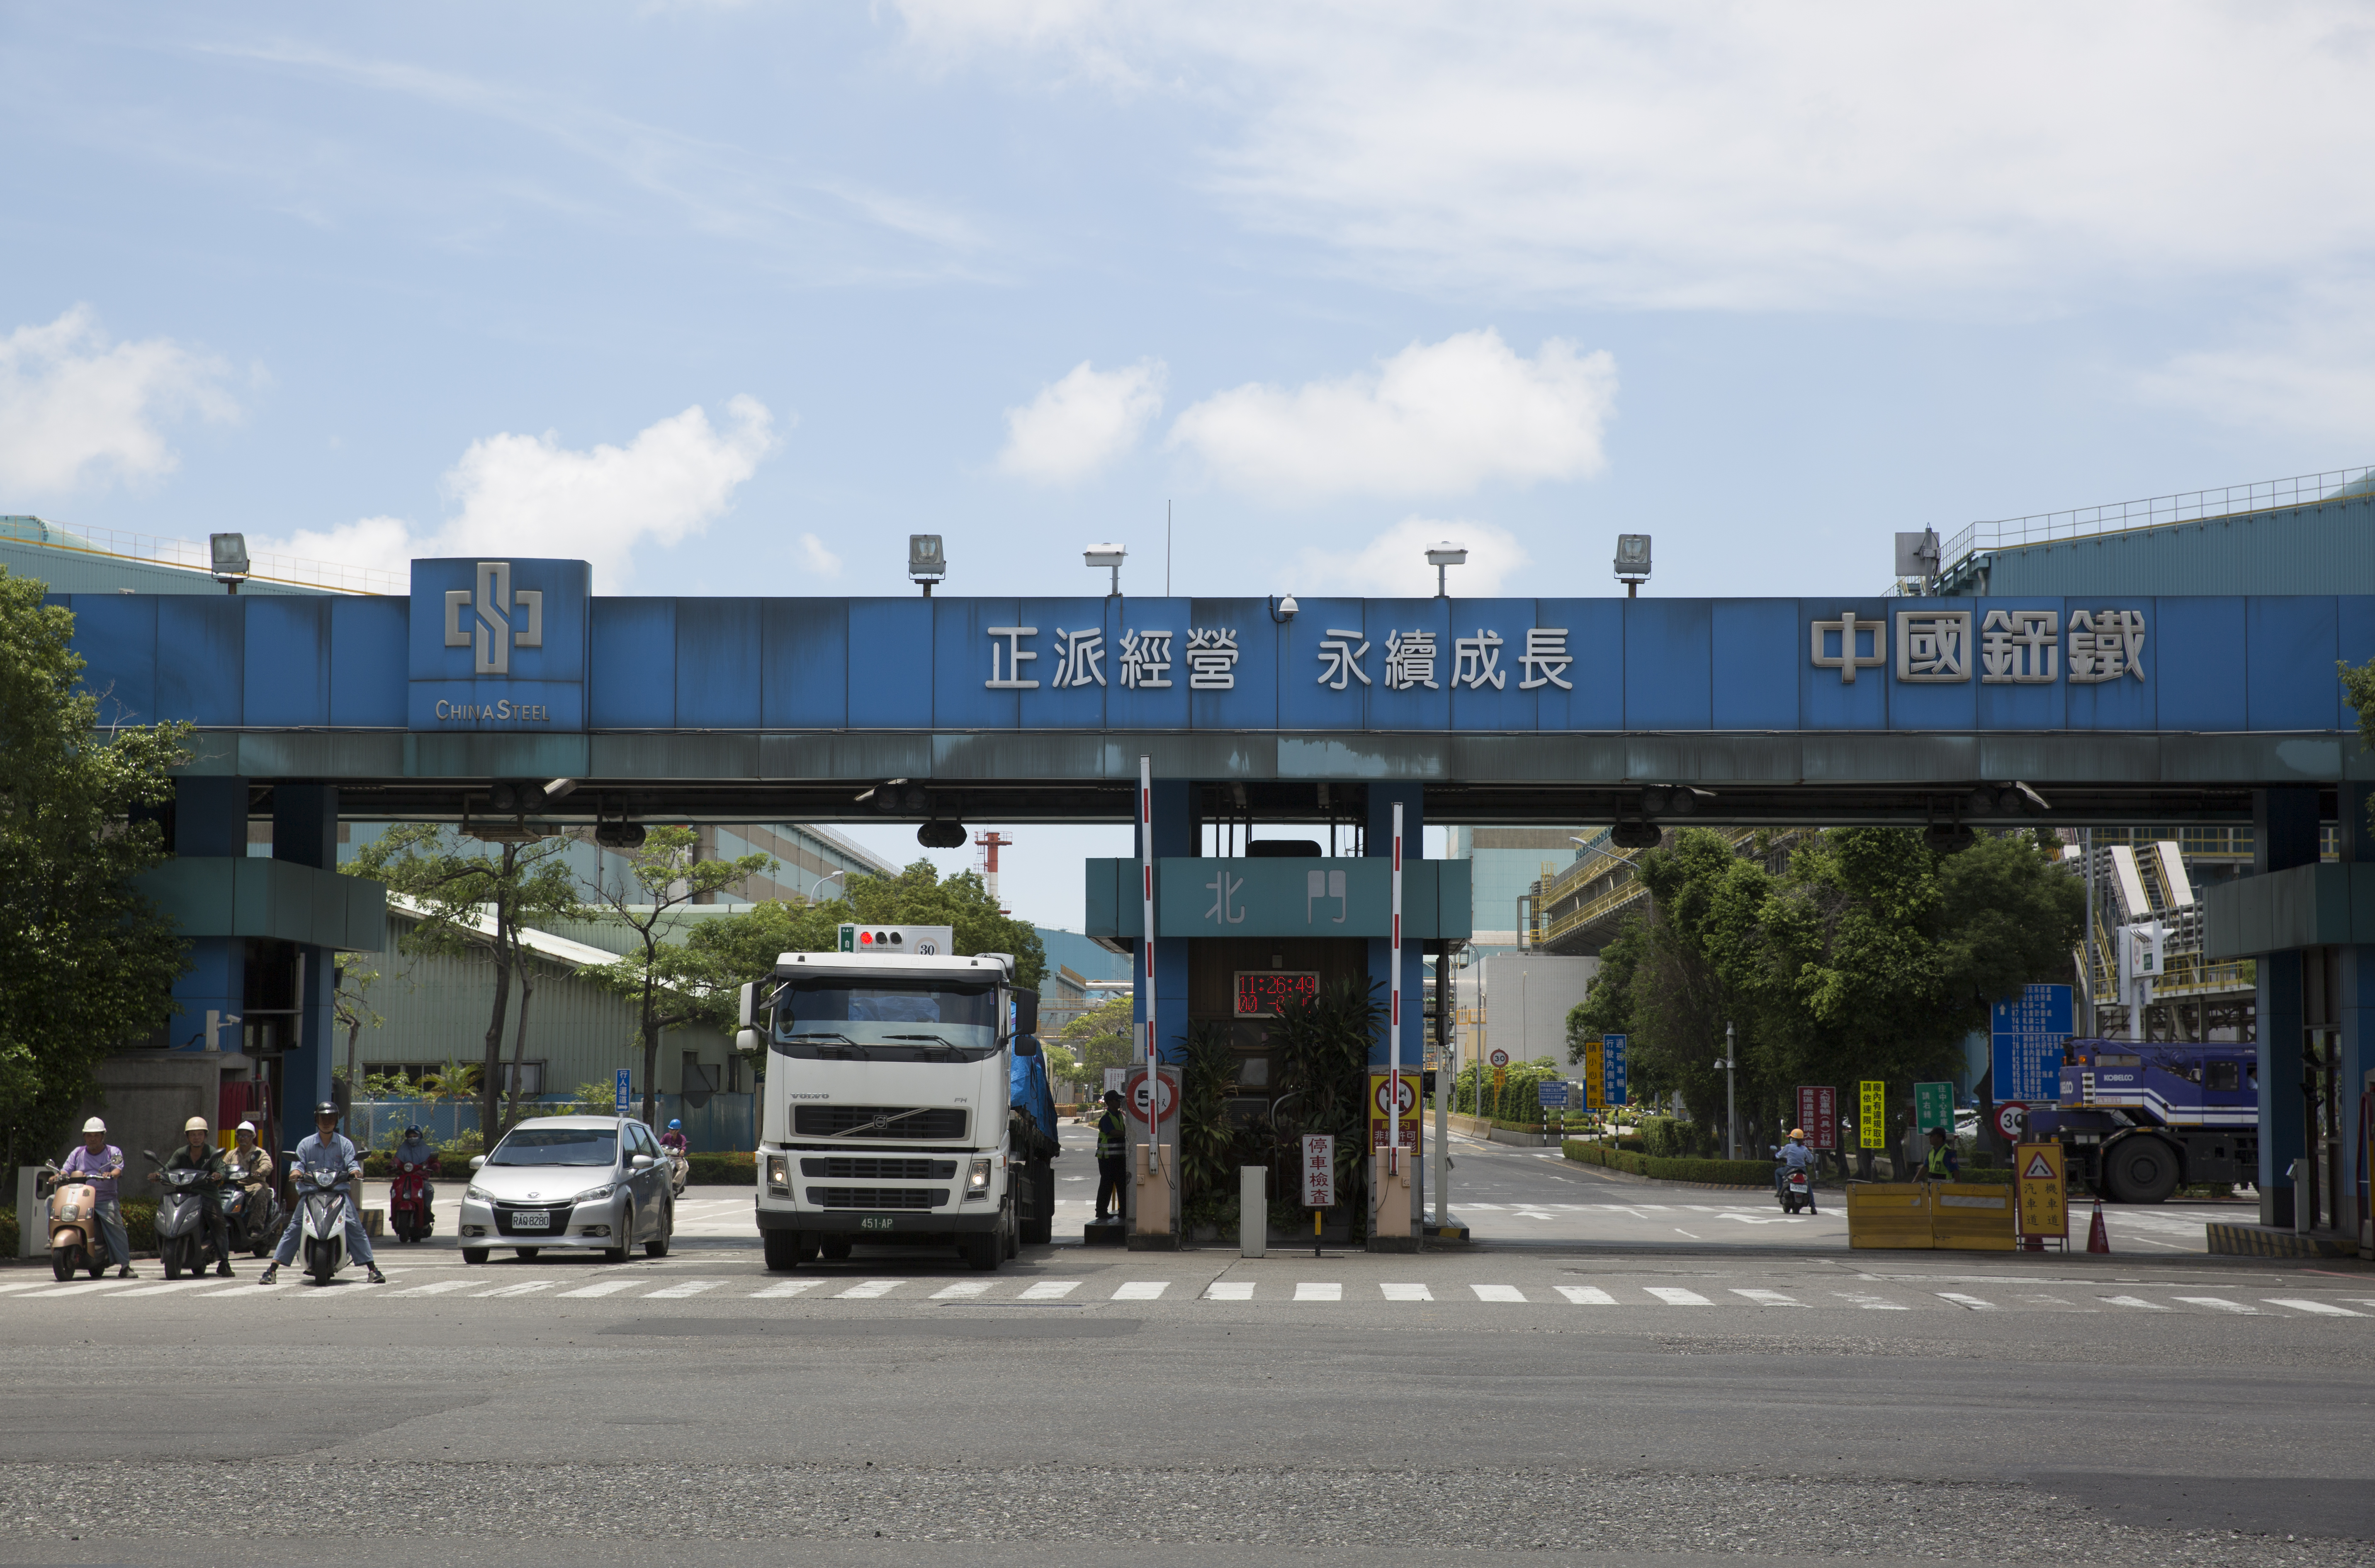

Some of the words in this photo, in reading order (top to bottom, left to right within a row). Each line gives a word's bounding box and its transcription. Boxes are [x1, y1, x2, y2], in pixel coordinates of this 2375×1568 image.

[985, 627, 1239, 689] 正派經營
[1318, 628, 1573, 690] 永續成長
[1811, 610, 2145, 683] 中國鋼鐵
[1204, 870, 1347, 924] 北門
[920, 944, 935, 955] 30
[1240, 976, 1314, 994] 11:26:49
[619, 1071, 628, 1104] 行人通道
[1588, 1045, 1597, 1106] 請小心駕駛
[1606, 1039, 1614, 1101] 行駛內側車道
[1803, 1089, 1814, 1147] 廠區道路請開大燈
[1863, 1083, 1872, 1147] 請依速限行駛
[1873, 1083, 1882, 1147] 廠內有違規取締
[1922, 1092, 1931, 1118] 請右轉
[1938, 1084, 1948, 1126] 往中心倉庫
[1308, 1138, 1329, 1204] 停車檢查
[513, 1216, 549, 1225] RAQ-8280
[861, 1218, 893, 1228] 451-AP
[2024, 1182, 2039, 1226] 汽車道
[2044, 1183, 2060, 1226] 機車道
